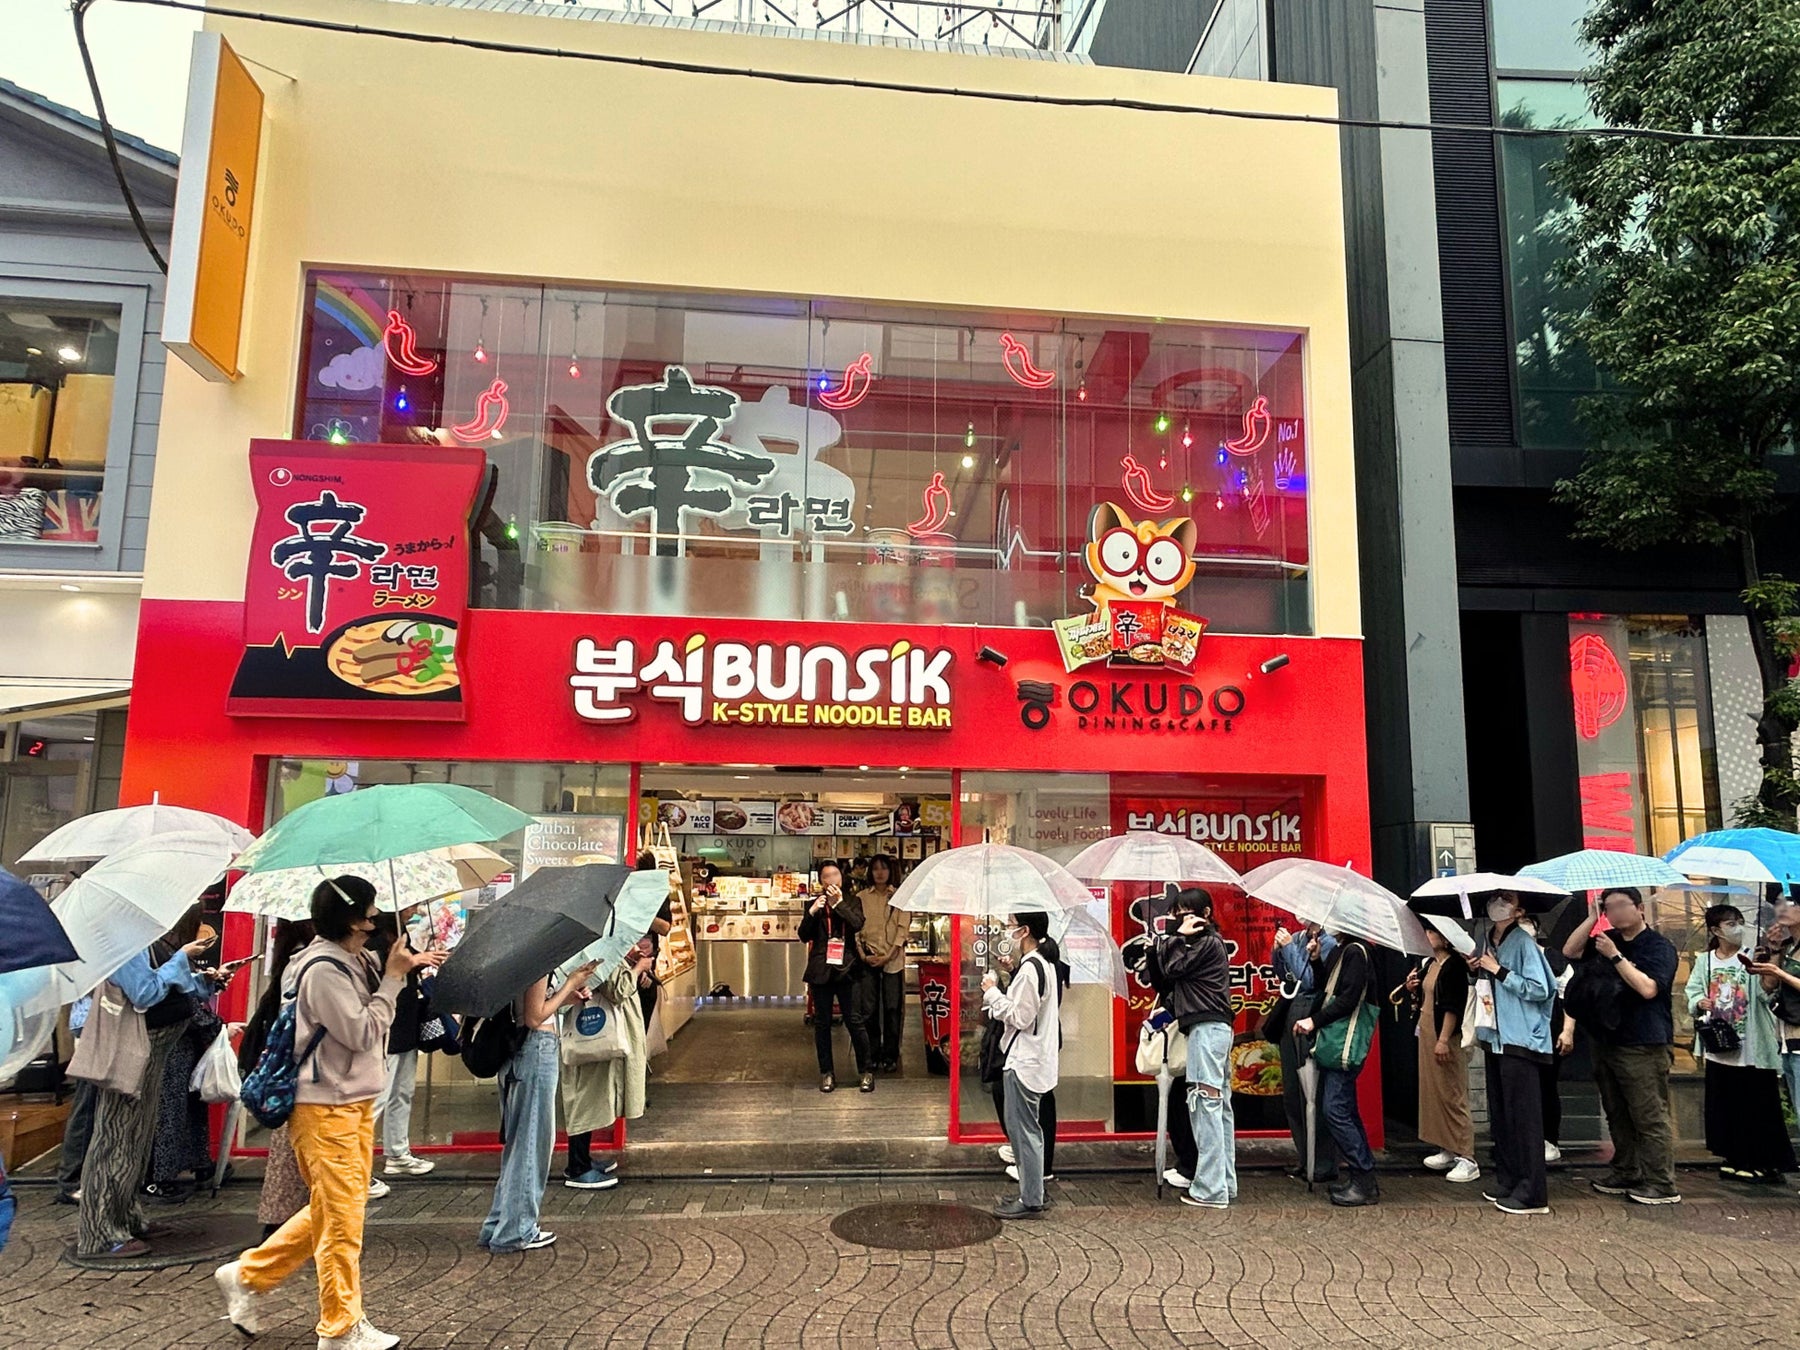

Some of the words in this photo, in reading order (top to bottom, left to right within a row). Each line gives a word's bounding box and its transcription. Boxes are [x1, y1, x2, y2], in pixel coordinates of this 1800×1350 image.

[212, 196, 245, 237] OKUDO
[1278, 419, 1299, 442] No.1
[293, 474, 342, 484] NONGSHIM
[747, 491, 856, 538] 라면
[271, 490, 388, 634] 辛
[370, 561, 439, 591] 라면
[277, 587, 303, 600] シン
[372, 590, 436, 609] ラーメン
[1115, 610, 1144, 647] 辛
[1167, 624, 1198, 640] 너구리
[569, 633, 706, 722] 분식
[1068, 680, 1246, 717] OKUDO
[713, 702, 808, 724] K-STYLE
[814, 704, 902, 726] NOODLE
[907, 706, 952, 728] BAR
[29, 742, 44, 755] 2
[1028, 806, 1069, 822] Lovely
[1073, 807, 1097, 819] Life
[529, 821, 576, 835] Dubai
[1028, 826, 1069, 843] Lovely
[527, 836, 604, 851] Chocolate
[713, 838, 767, 849] OKUDO
[1237, 842, 1279, 853] NOODLE
[1280, 843, 1302, 854] BAR
[526, 852, 569, 866] Sweets
